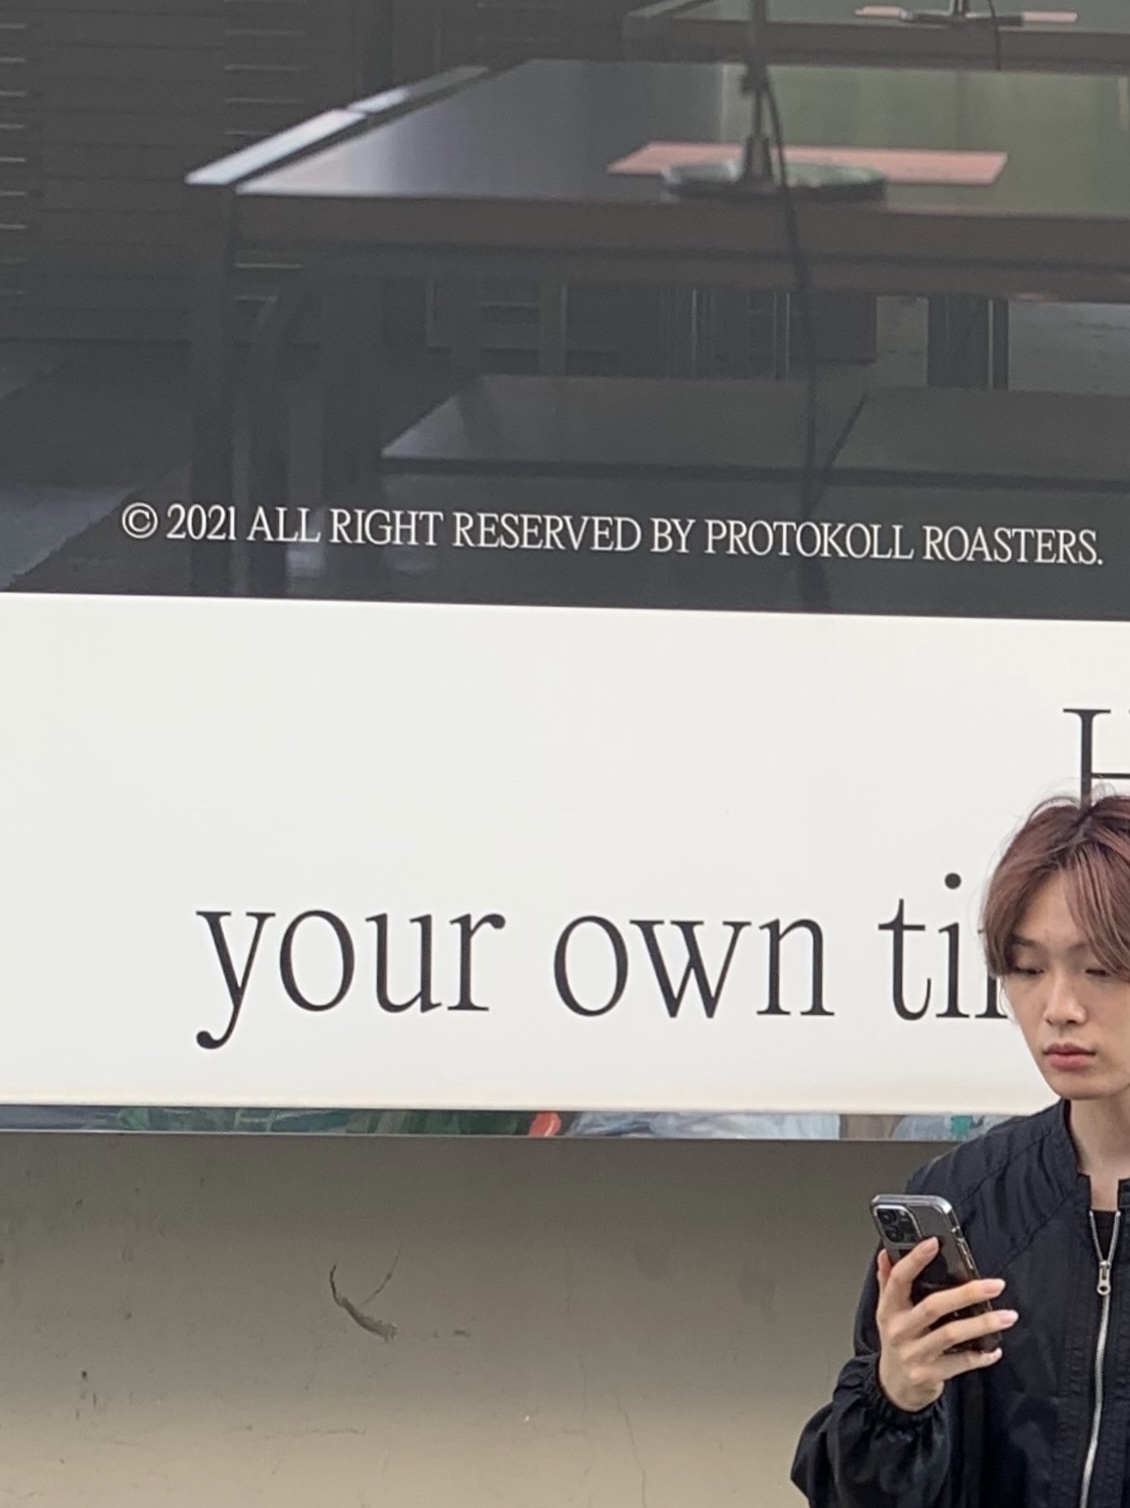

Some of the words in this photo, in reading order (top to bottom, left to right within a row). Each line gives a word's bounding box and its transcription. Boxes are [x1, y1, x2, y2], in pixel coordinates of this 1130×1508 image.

[121, 502, 159, 539] ©
[165, 503, 237, 541] 2021
[246, 505, 322, 543] ALL
[329, 508, 444, 546] RIGHT
[452, 511, 642, 552] RESERVED
[650, 517, 697, 554] BY
[704, 518, 915, 560] PROTOKOLL
[922, 525, 1104, 566] ROASTERS.
[196, 910, 506, 1050] your
[554, 913, 835, 1019] own
[878, 872, 1009, 1021] ti
